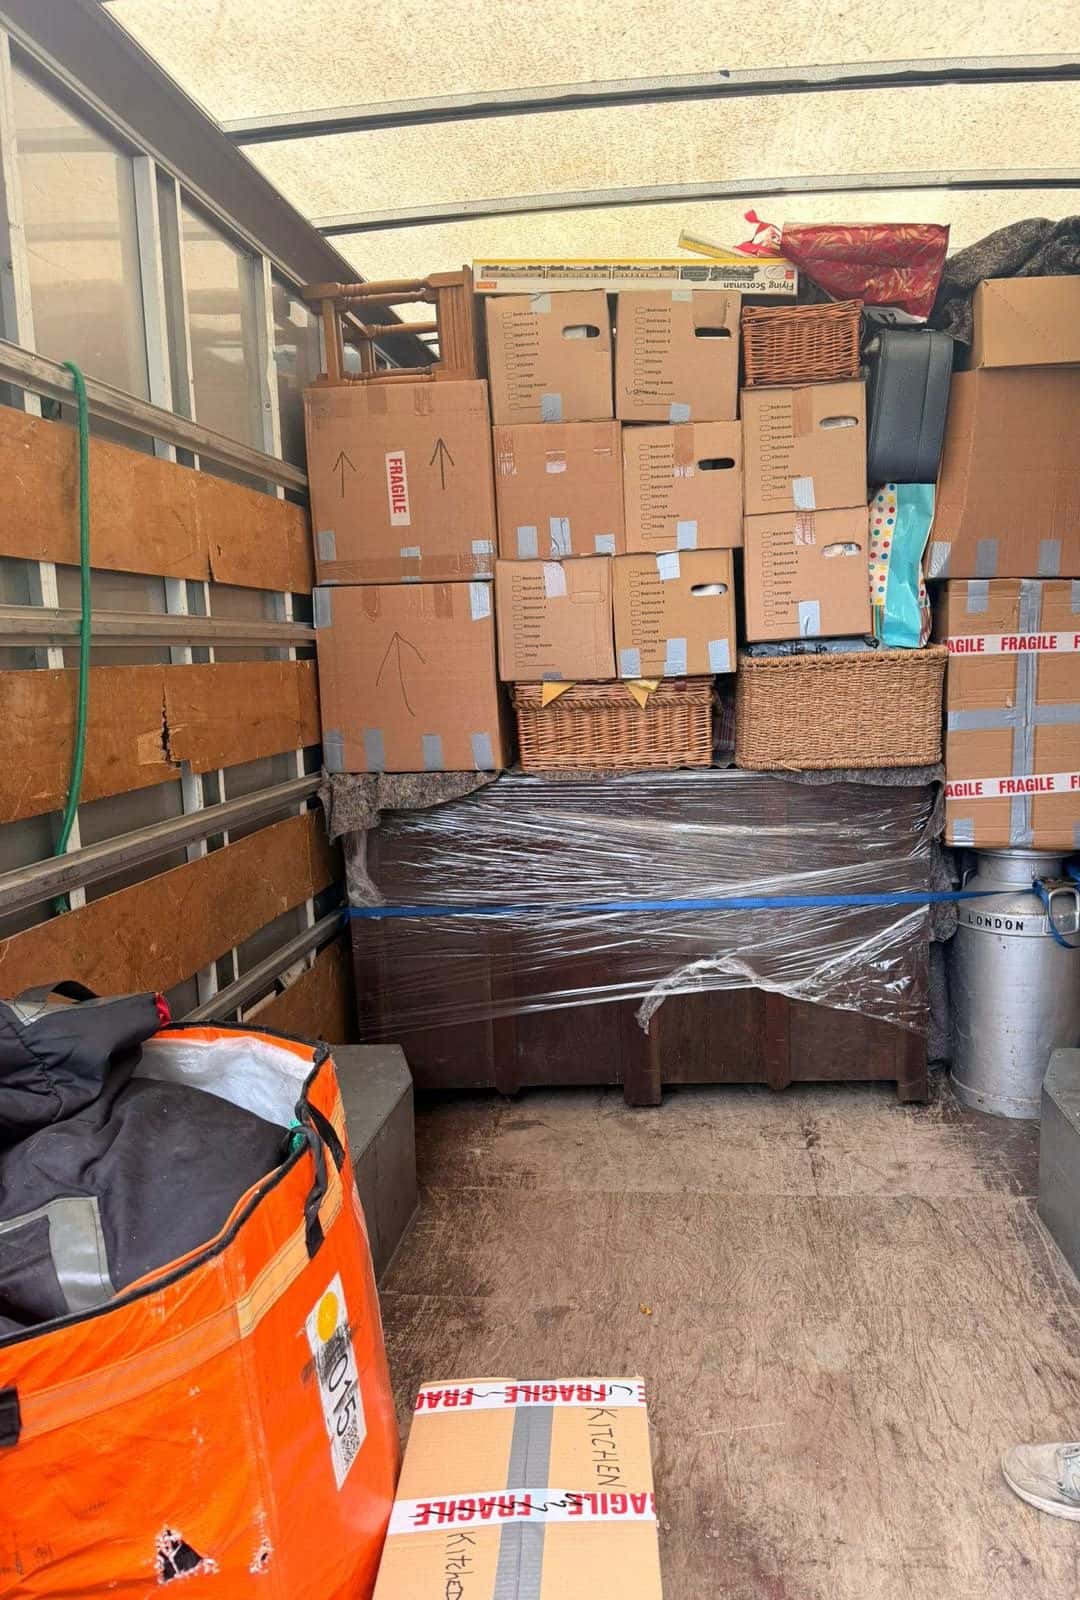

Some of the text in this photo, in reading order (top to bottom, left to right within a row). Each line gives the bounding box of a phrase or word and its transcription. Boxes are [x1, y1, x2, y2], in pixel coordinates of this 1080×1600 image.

[723, 280, 794, 291] Flying Scotsman
[389, 458, 407, 514] FRAGILE
[1001, 635, 1057, 651] FRAGILE
[999, 777, 1055, 794] FRAGILE
[967, 912, 1024, 931] LONDON
[503, 1383, 607, 1404] FRAGILE
[584, 1407, 627, 1488] KITCHEN
[413, 1494, 532, 1527] FRAGILE
